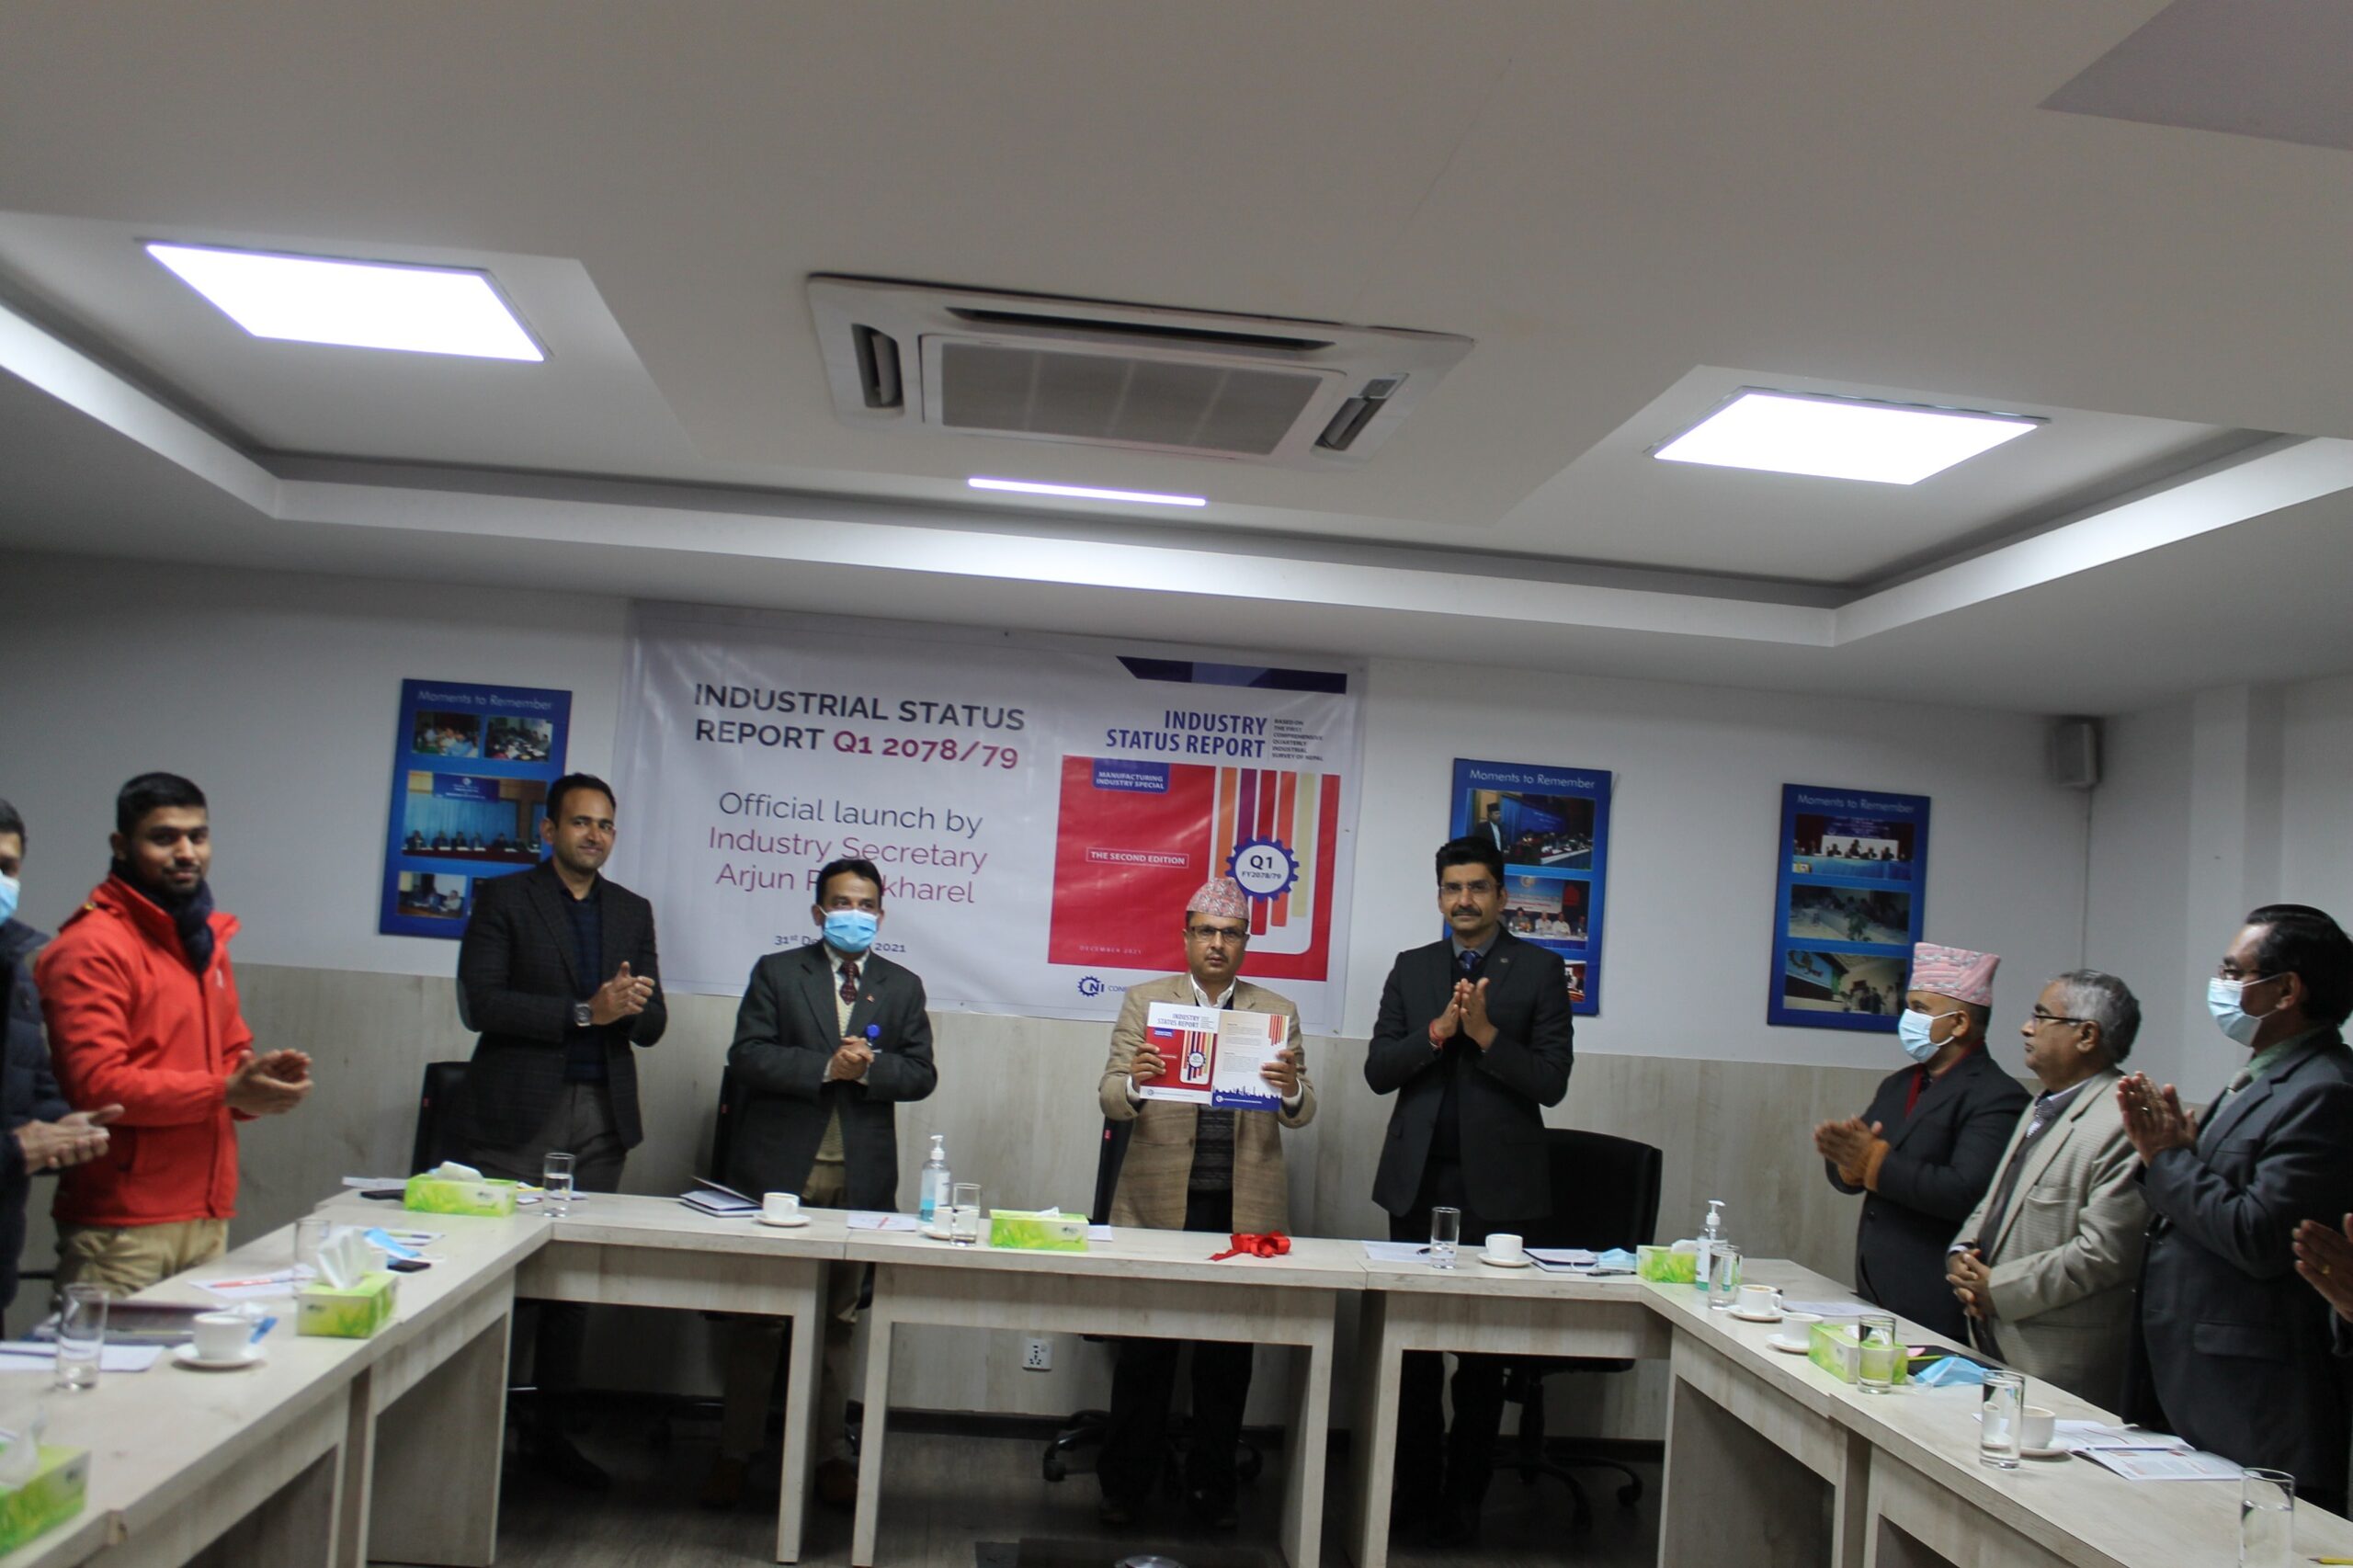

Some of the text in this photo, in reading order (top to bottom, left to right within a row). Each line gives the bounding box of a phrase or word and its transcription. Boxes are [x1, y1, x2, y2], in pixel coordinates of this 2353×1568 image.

[418, 690, 552, 710] Moments to Remember
[694, 683, 1025, 732] INDUSTRIAL STATUS
[1165, 710, 1268, 736] INDUSTRY
[696, 718, 1018, 769] REPORT Q1 2078/79
[1106, 728, 1266, 758] STATUS REPORT
[1096, 778, 1165, 790] INDUSTRY SPECIAL
[1098, 771, 1164, 782] MANUFACTURING
[1471, 768, 1596, 790] Moments to Remember
[1798, 793, 1915, 814] Moments to Remember
[719, 791, 983, 839] Official launch by
[709, 826, 988, 873] Industry Secretary
[1090, 851, 1186, 866] THE SECOND EDITION
[1250, 855, 1273, 870] Q1
[715, 862, 794, 893] Arjun
[774, 934, 798, 946] 31st
[874, 942, 906, 953] 2021
[1079, 945, 1120, 953] DECEMBER
